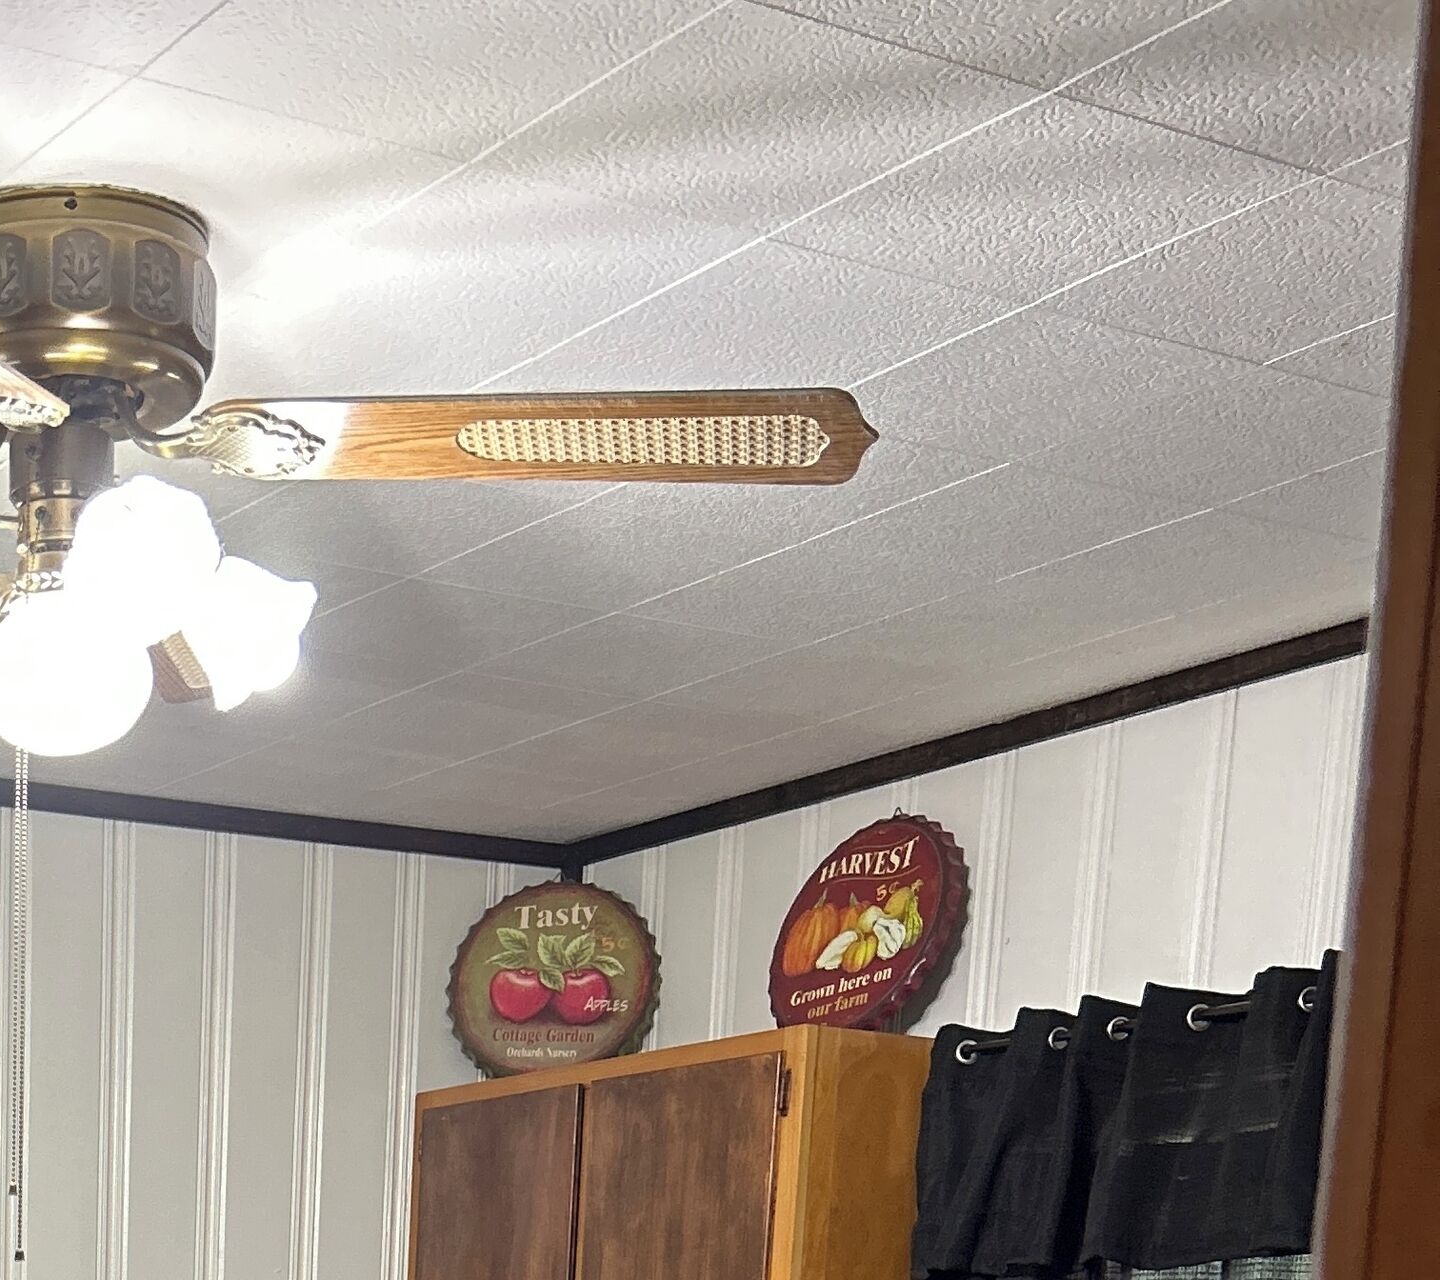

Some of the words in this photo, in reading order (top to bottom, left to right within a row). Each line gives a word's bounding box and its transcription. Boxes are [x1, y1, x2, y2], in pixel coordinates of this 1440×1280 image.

[819, 836, 920, 884] HARVEST
[514, 902, 598, 931] Tasty
[790, 981, 835, 1007] Grown
[837, 975, 871, 994] here
[873, 966, 893, 982] on
[807, 1002, 833, 1020] our
[834, 990, 869, 1012] farm
[492, 1027, 543, 1044] Cottage
[546, 1027, 595, 1043] Garden
[506, 1046, 544, 1058] Orchards
